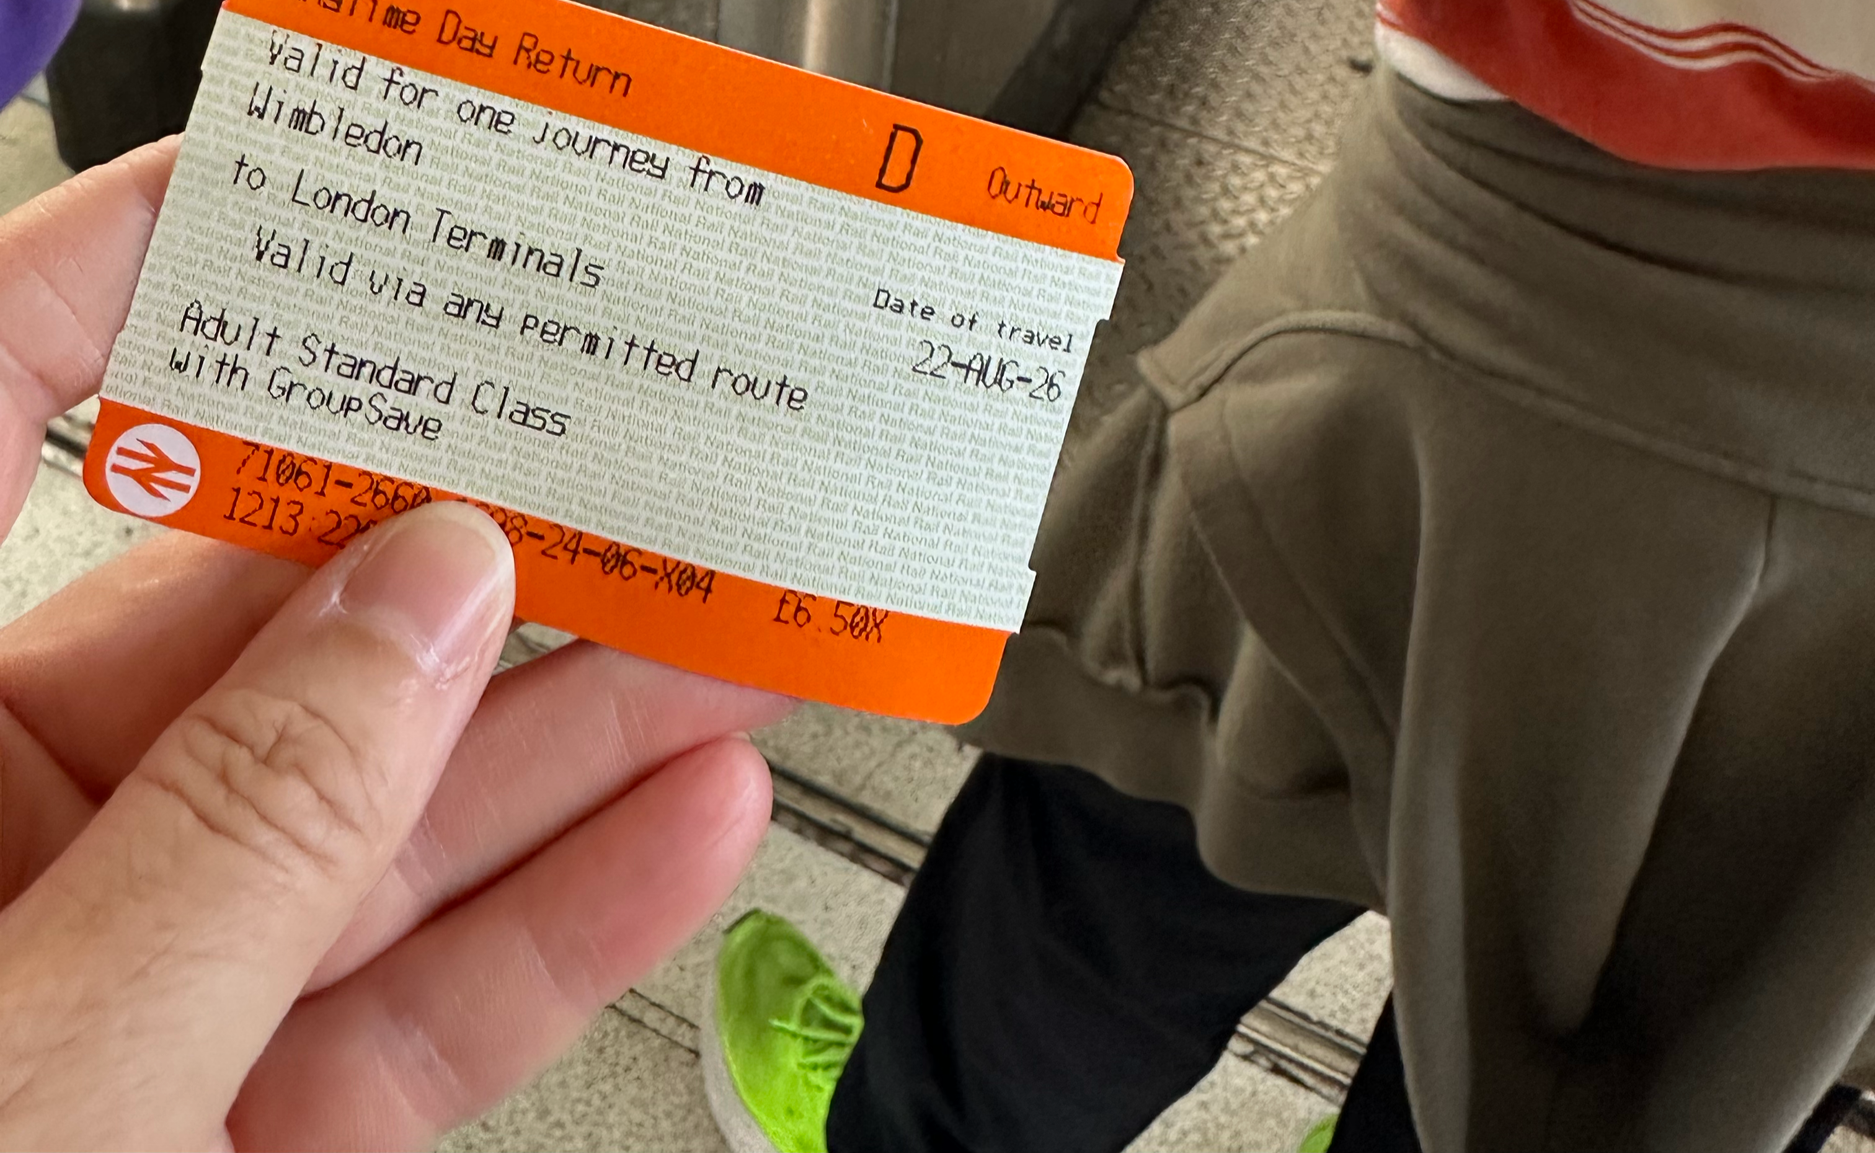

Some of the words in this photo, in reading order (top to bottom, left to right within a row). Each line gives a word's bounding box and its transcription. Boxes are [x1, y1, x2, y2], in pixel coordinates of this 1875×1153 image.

[436, 8, 499, 59] Day
[512, 32, 633, 98] Return
[246, 81, 423, 166] Wimbledon
[269, 30, 366, 91] Valid
[383, 64, 438, 111] for
[456, 99, 516, 135] one
[532, 112, 670, 180] journey
[689, 155, 766, 206] from
[875, 123, 924, 194] D
[233, 154, 267, 191] to
[291, 168, 411, 235] London
[432, 207, 605, 289] Terminals
[987, 166, 1104, 225] Outward
[255, 224, 354, 287] Valid
[369, 269, 427, 308] via
[443, 292, 505, 330] any
[711, 365, 808, 412] route
[873, 288, 936, 321] Date
[996, 318, 1074, 354] travel
[179, 299, 281, 357] Adult
[298, 332, 458, 405] Standard
[471, 380, 572, 437] Class
[911, 339, 1066, 403] 22-AUG-26
